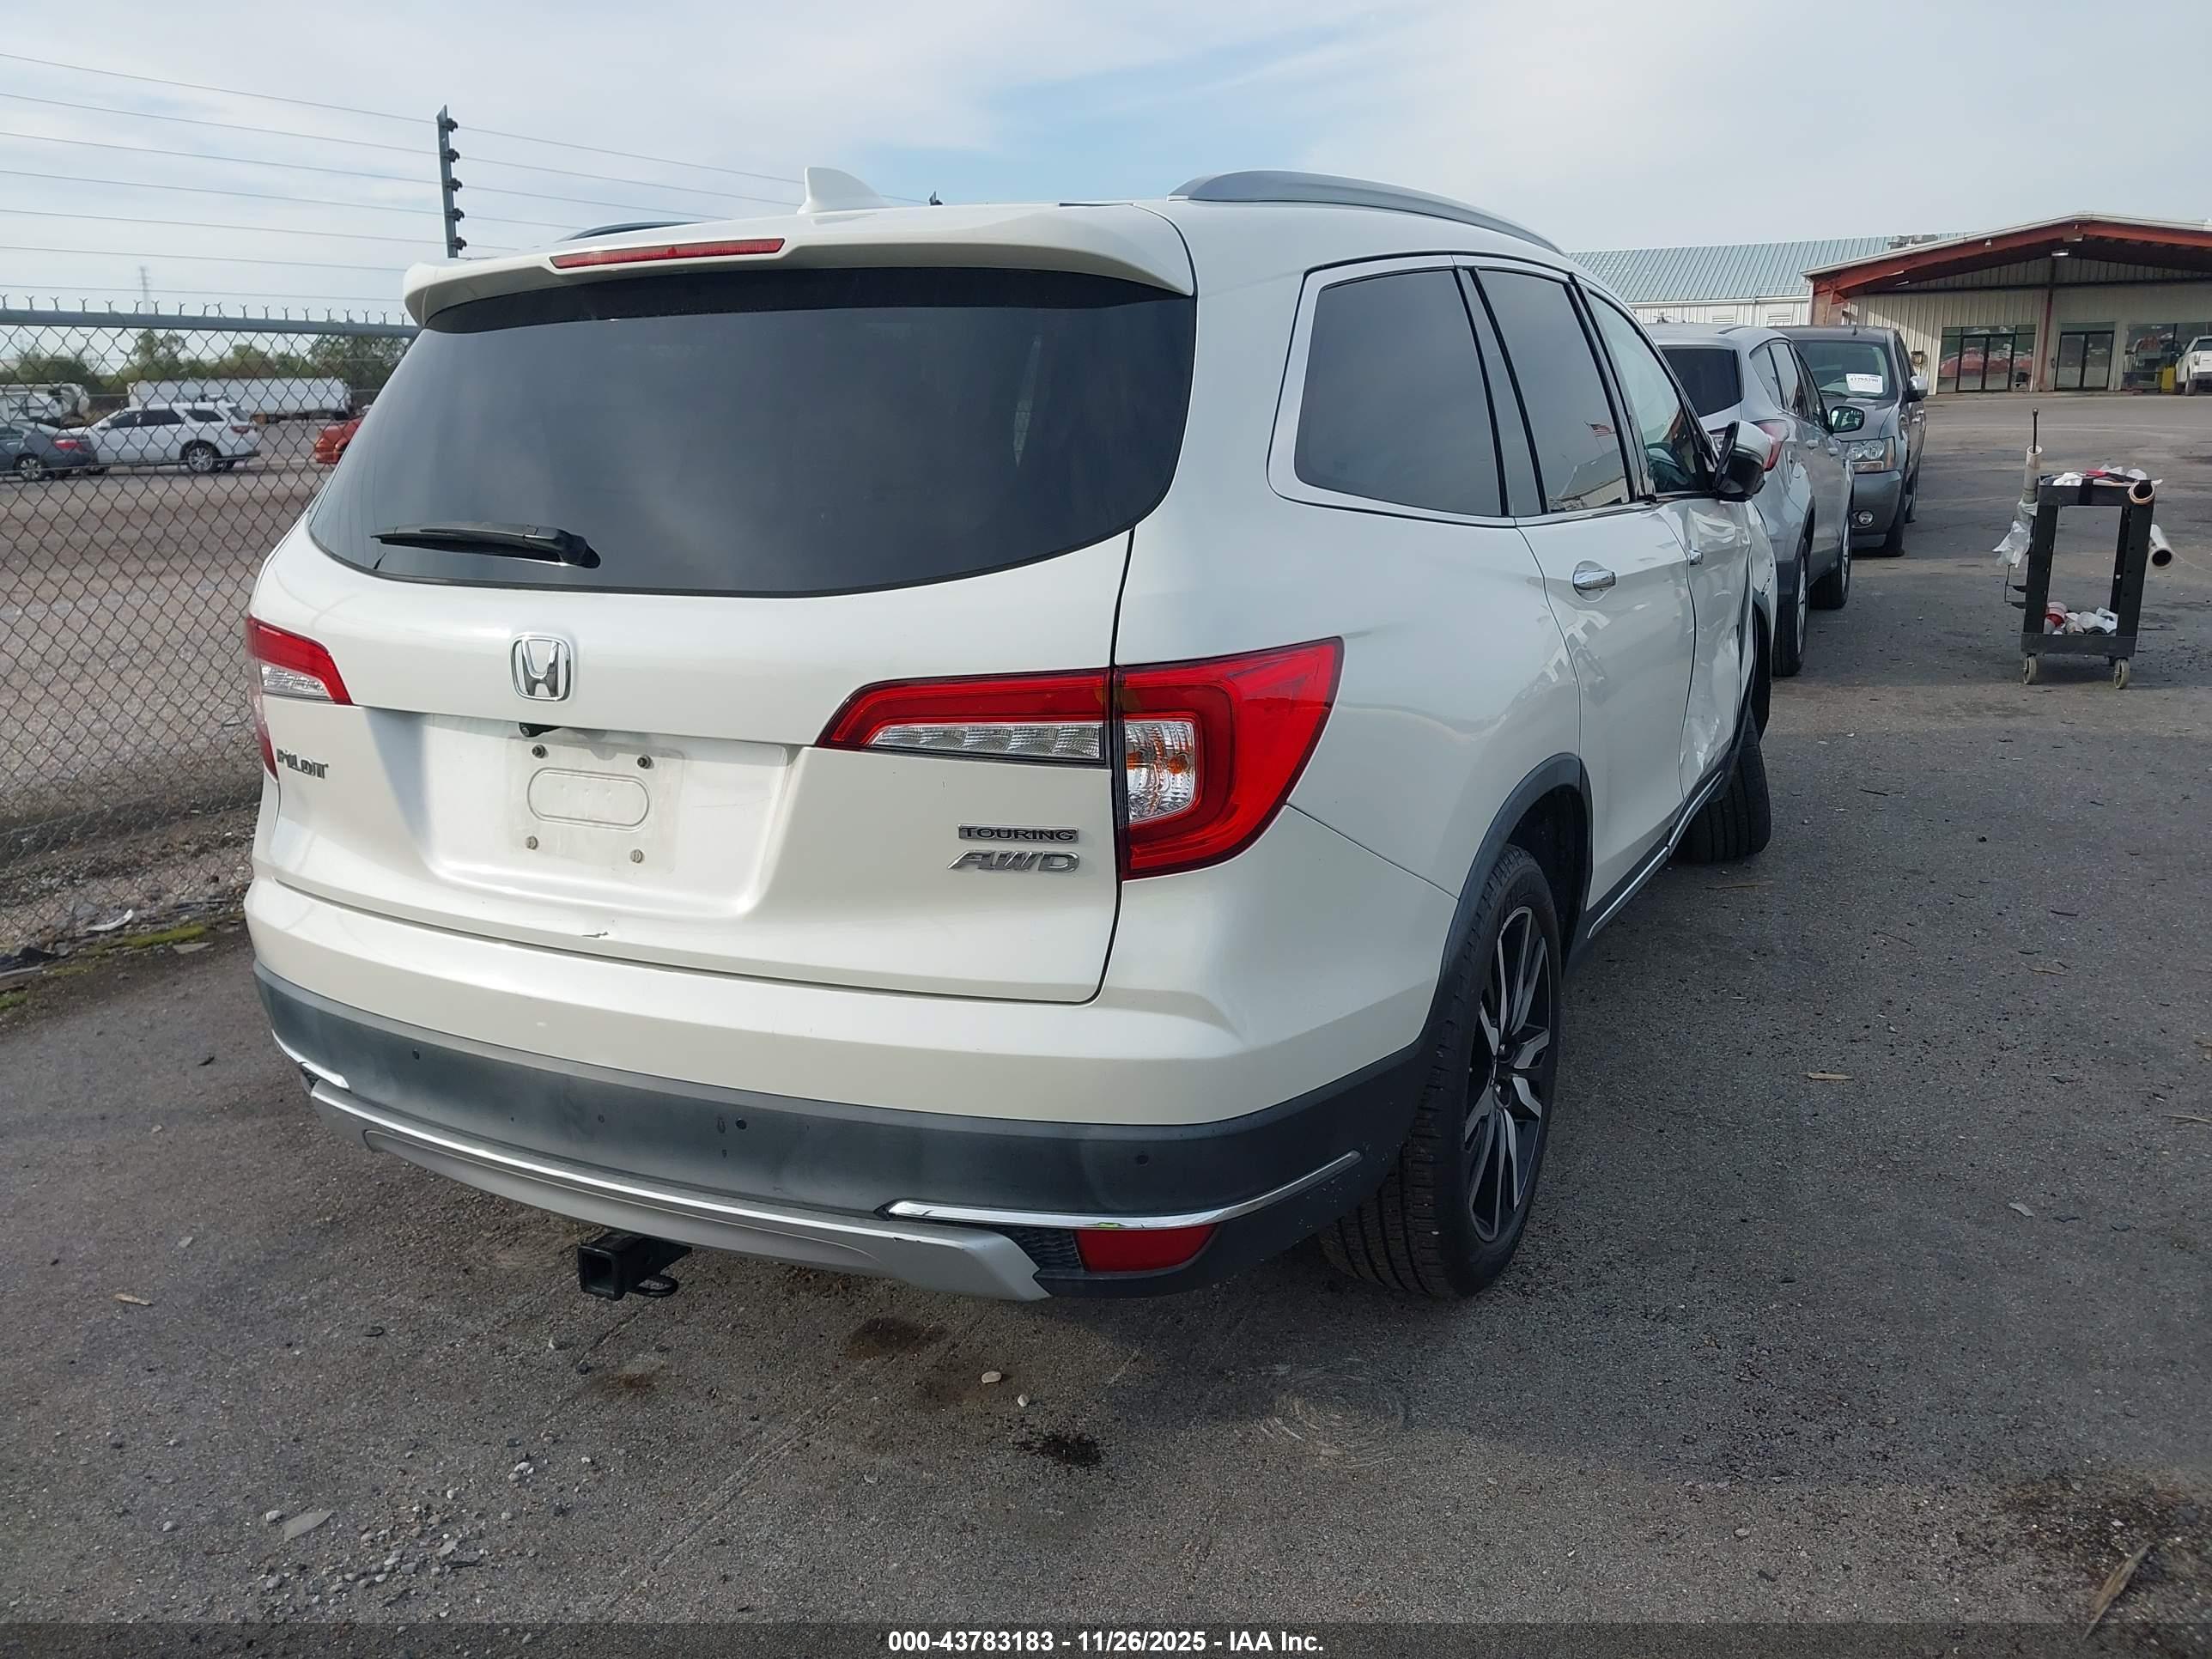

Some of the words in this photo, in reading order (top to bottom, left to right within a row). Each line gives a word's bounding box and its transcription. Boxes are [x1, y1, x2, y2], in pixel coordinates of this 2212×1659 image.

[276, 749, 329, 779] PILOT
[960, 825, 1078, 842] TOURING
[947, 849, 1080, 872] AWD
